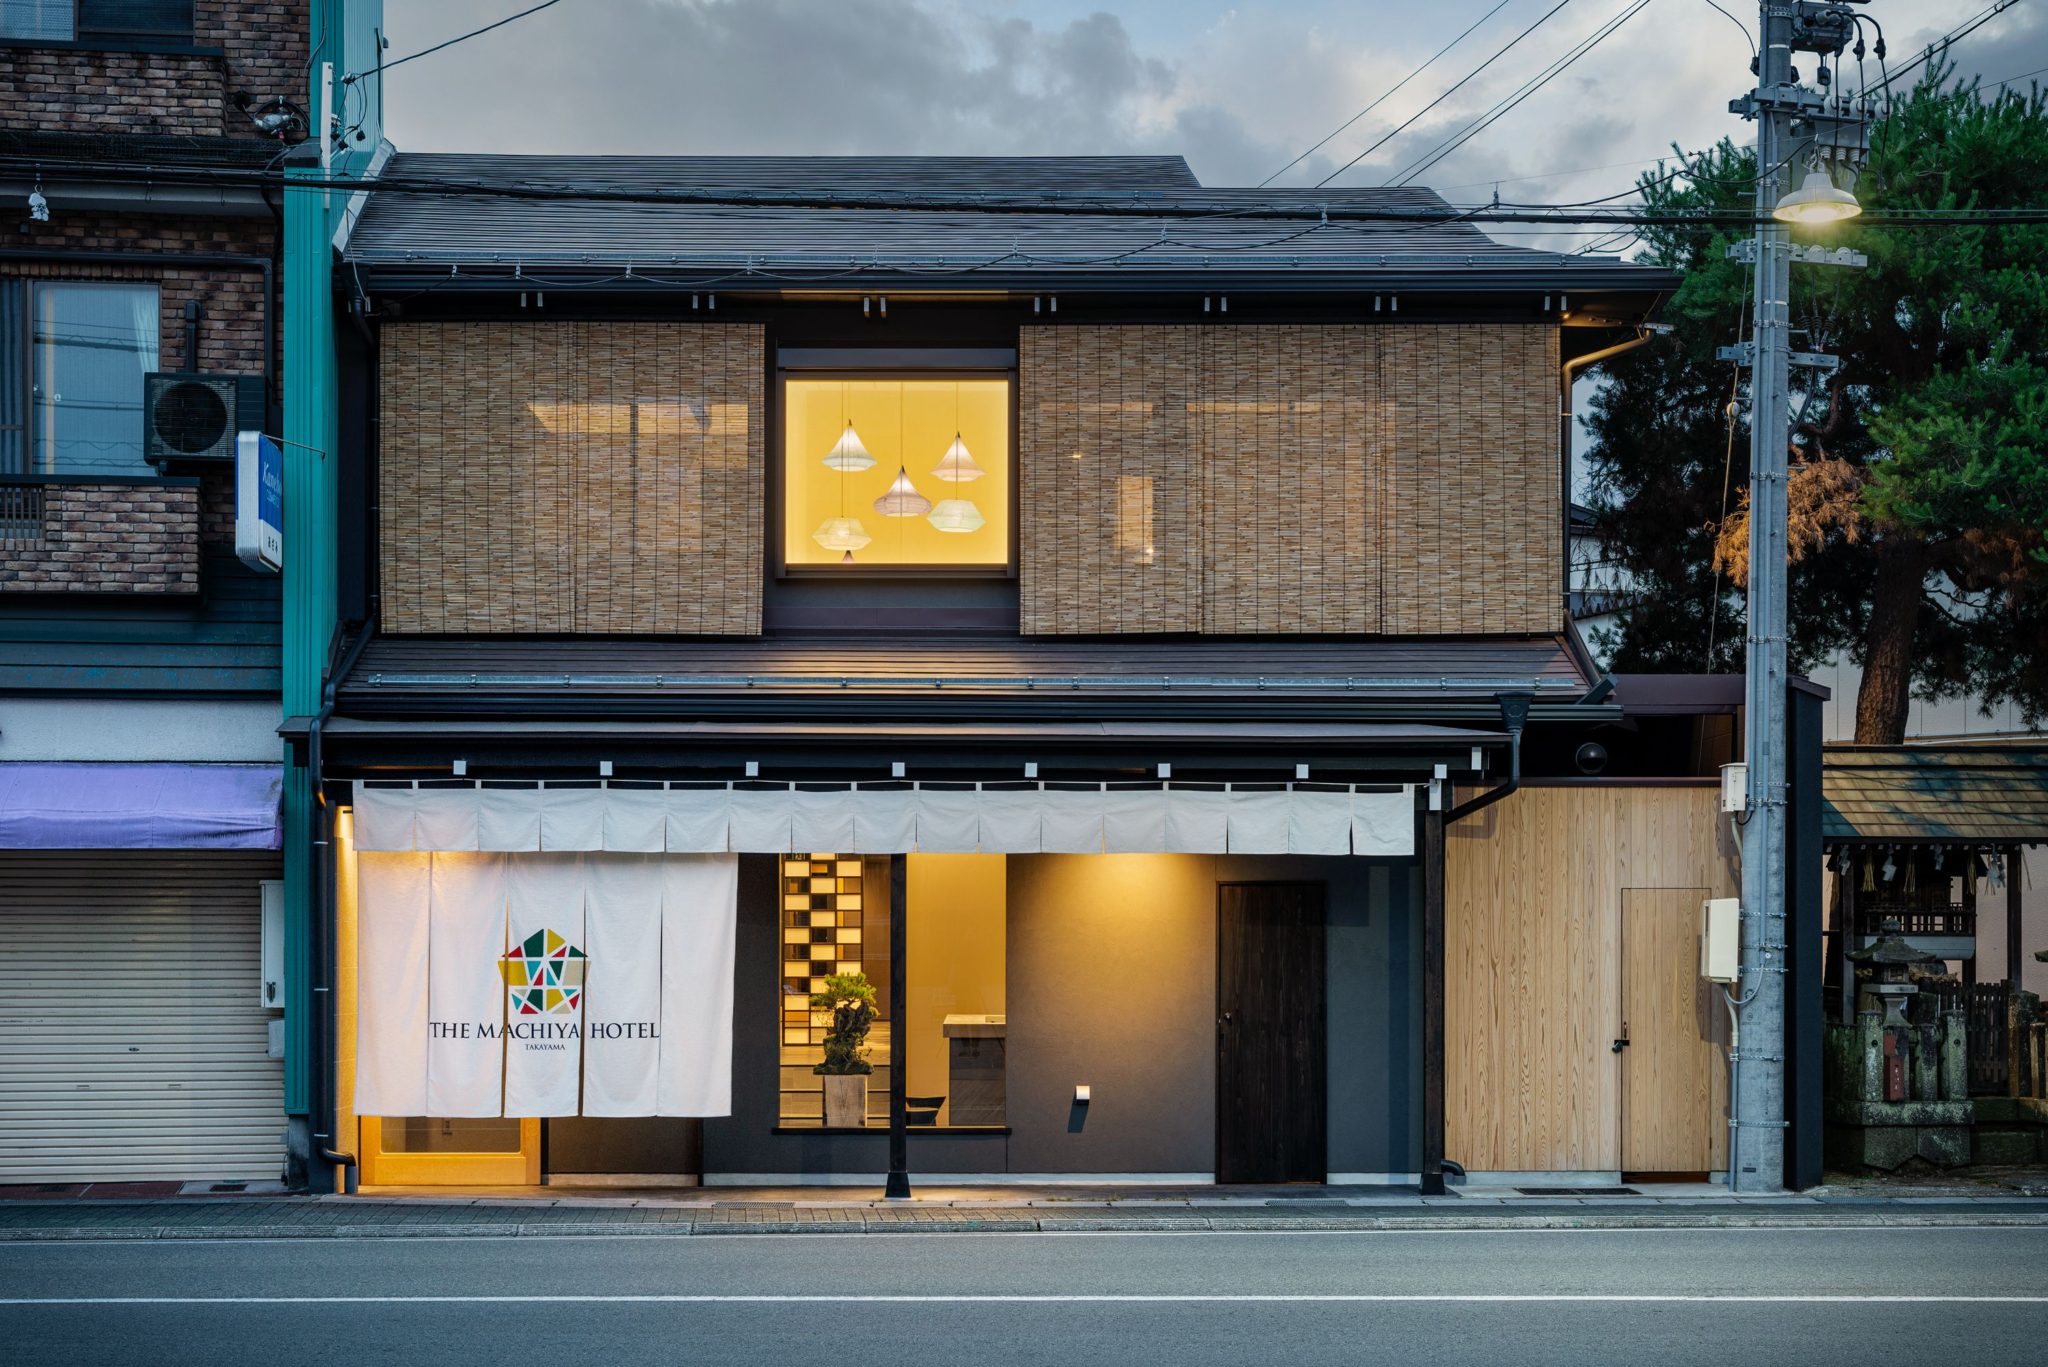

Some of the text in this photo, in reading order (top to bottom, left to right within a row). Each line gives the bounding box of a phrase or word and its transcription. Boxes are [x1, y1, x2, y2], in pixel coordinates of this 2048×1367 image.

[429, 1022, 660, 1039] THE MACHIYA HOTEL
[525, 1043, 566, 1051] TAKAYAMA
